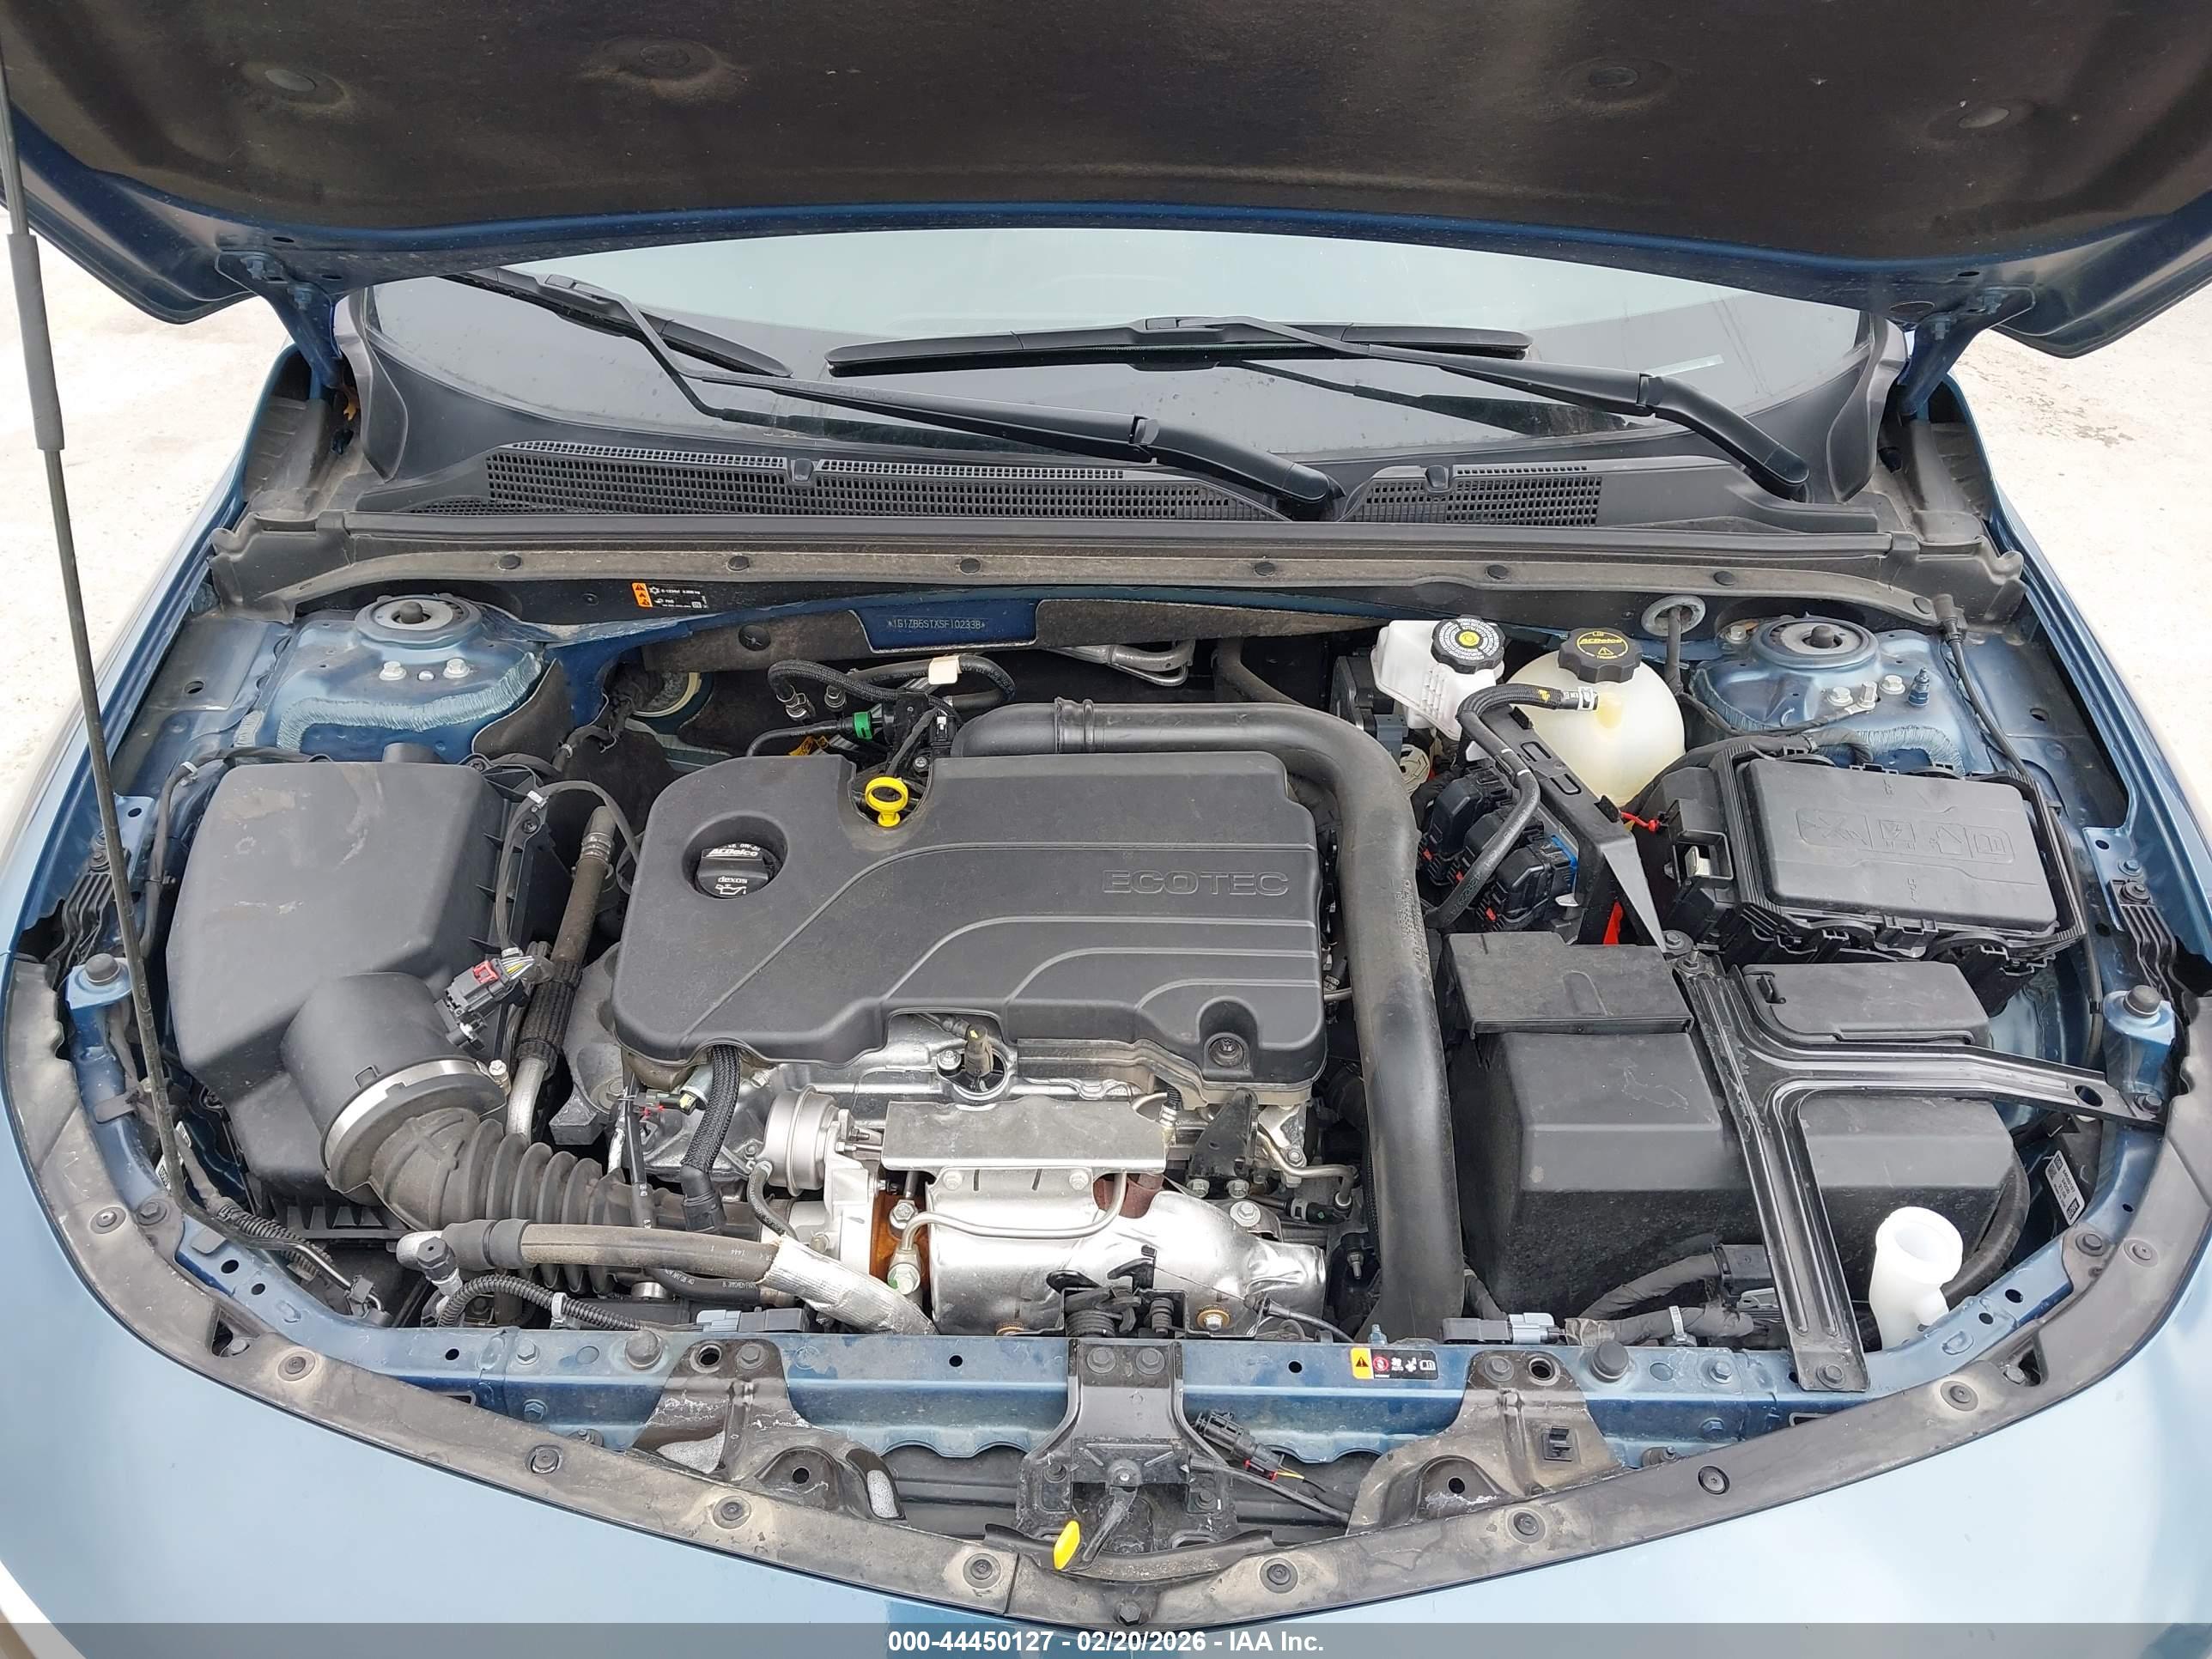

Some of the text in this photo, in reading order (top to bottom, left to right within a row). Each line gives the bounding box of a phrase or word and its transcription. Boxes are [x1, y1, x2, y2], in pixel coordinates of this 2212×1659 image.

[706, 848, 759, 858] ACDelco
[718, 875, 748, 884] dexos
[1102, 869, 1290, 897] ECOTEC
